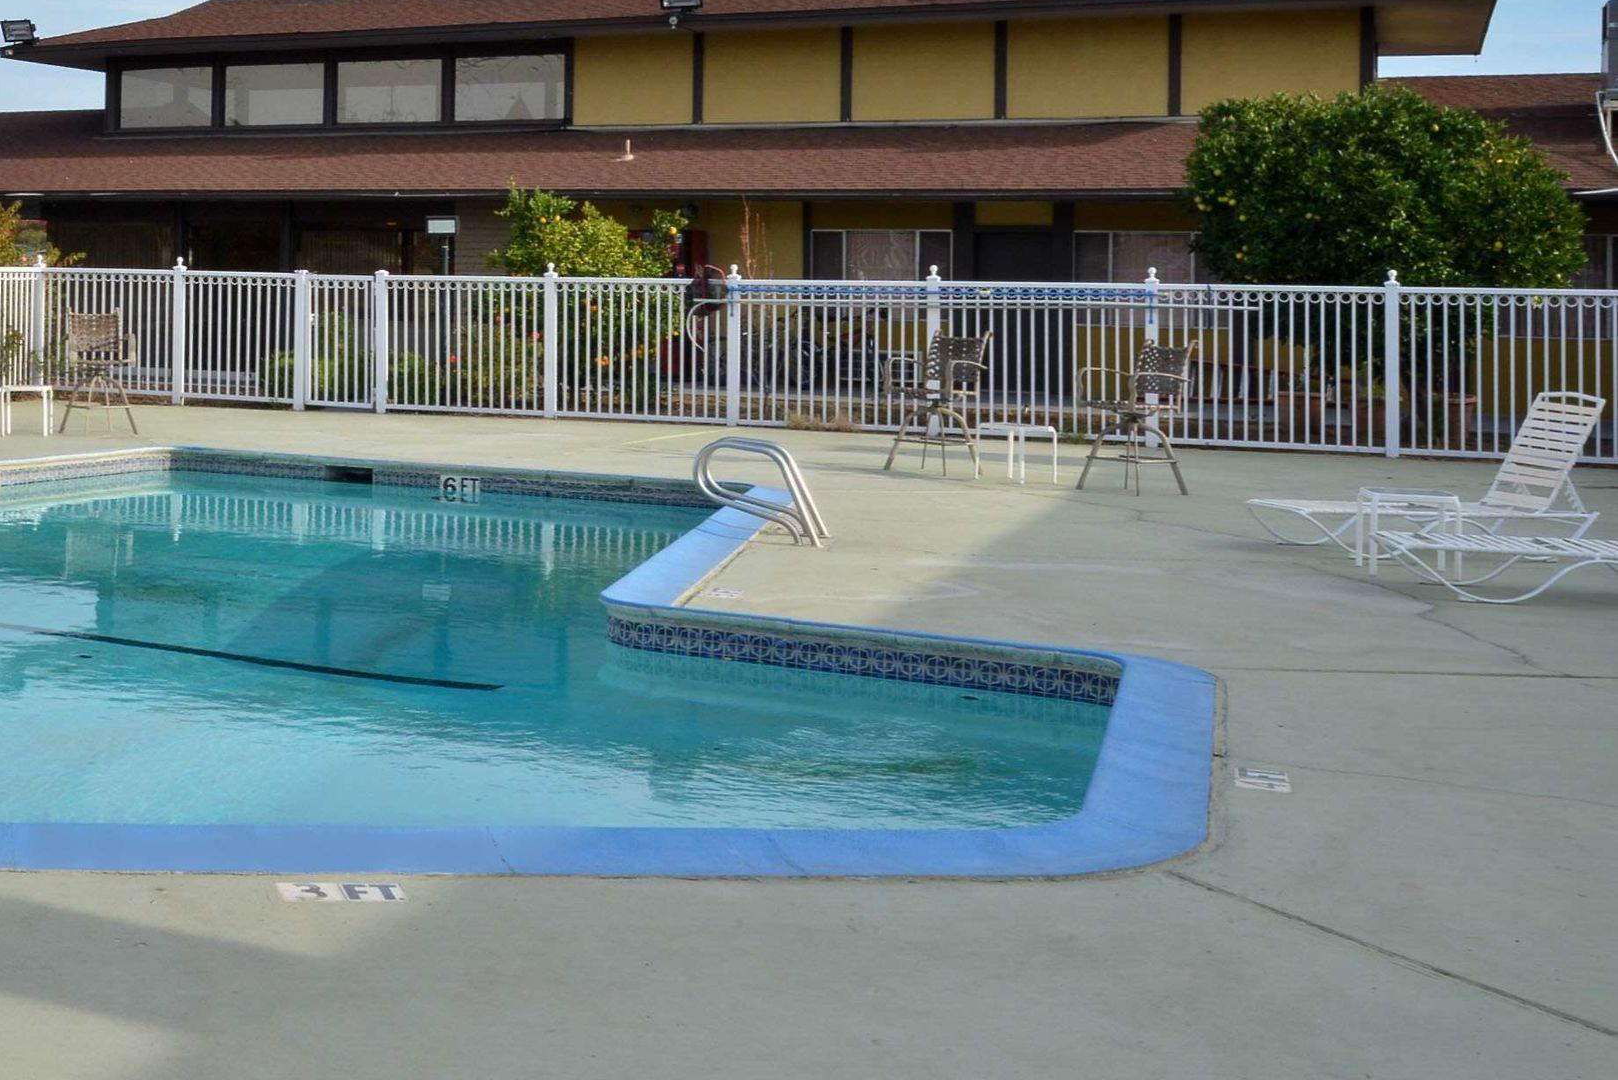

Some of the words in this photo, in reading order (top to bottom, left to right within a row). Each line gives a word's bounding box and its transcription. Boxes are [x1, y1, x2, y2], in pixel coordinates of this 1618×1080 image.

[443, 477, 456, 493] 6
[461, 477, 479, 492] FT
[293, 883, 328, 899] 3
